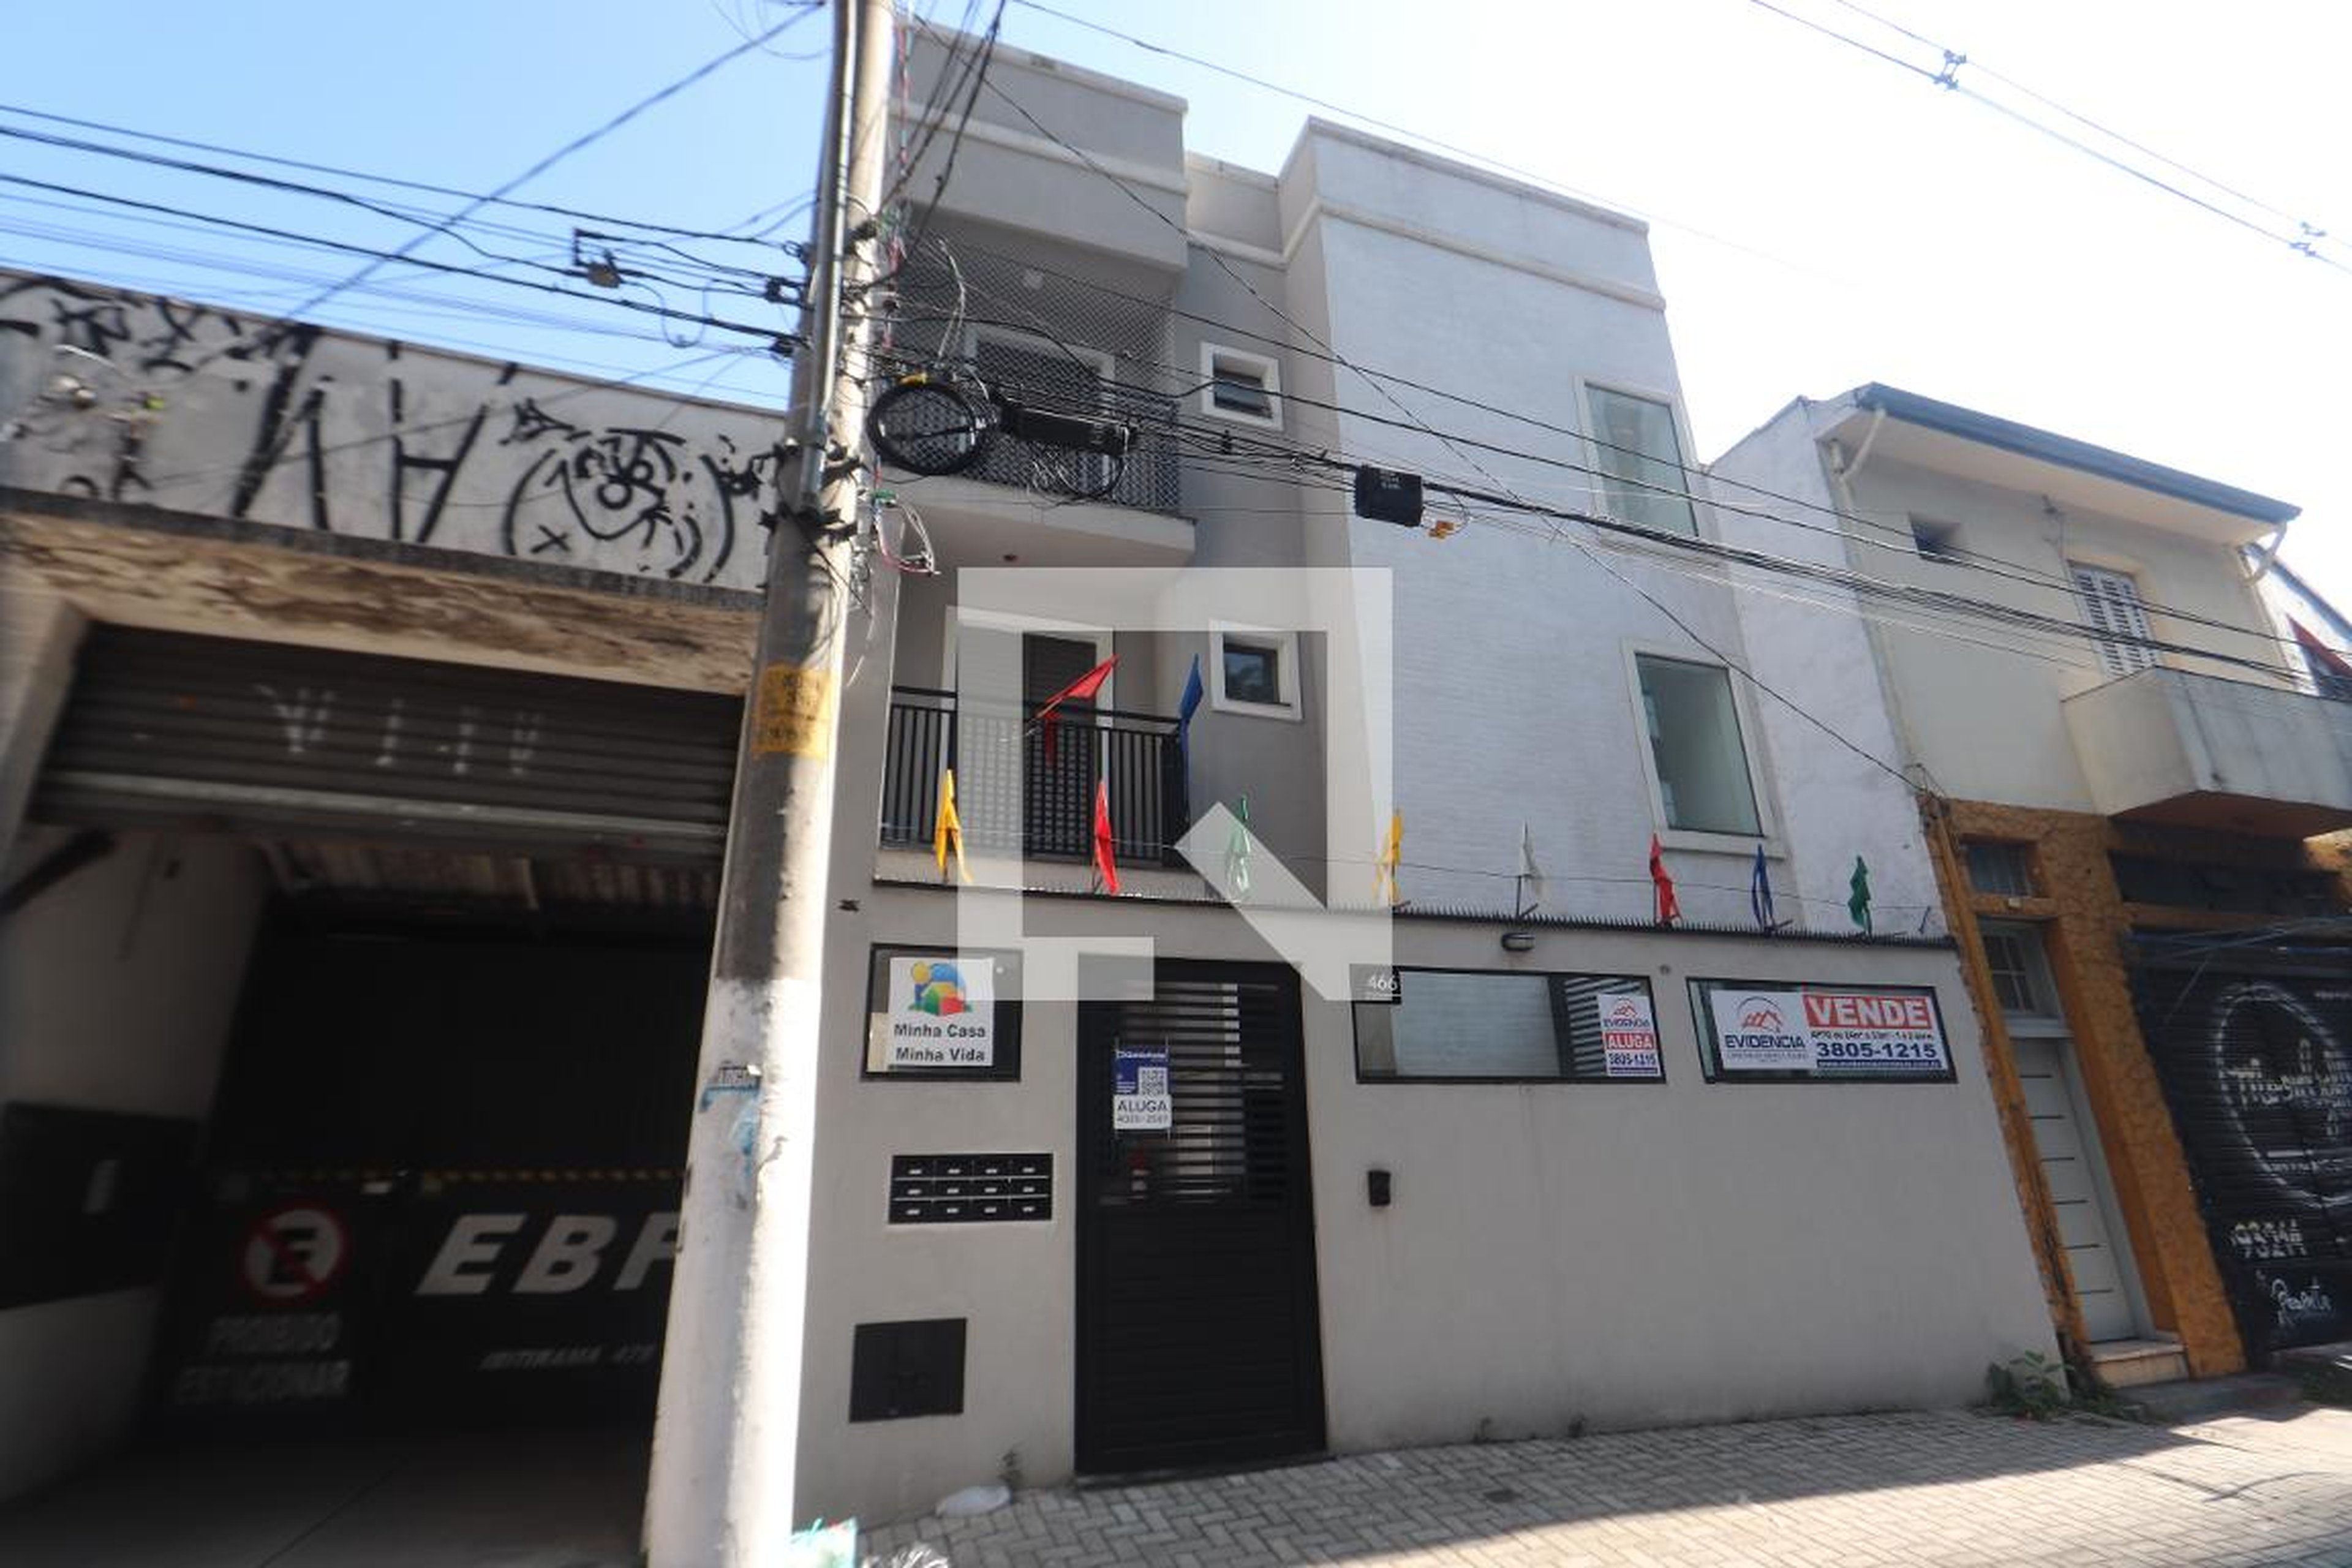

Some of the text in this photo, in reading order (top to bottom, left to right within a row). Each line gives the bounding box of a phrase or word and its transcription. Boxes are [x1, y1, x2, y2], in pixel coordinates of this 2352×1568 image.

[1368, 974, 1397, 990] 466
[1809, 997, 1929, 1027] VENDE
[894, 1024, 986, 1038] Minha Casa
[1608, 1035, 1653, 1048] ALUGA
[1725, 1035, 1806, 1049] EVIDENCIA
[895, 1047, 985, 1061] Minha Vida
[1817, 1042, 1937, 1058] 3805-1215
[1117, 1101, 1167, 1112] ALUGA
